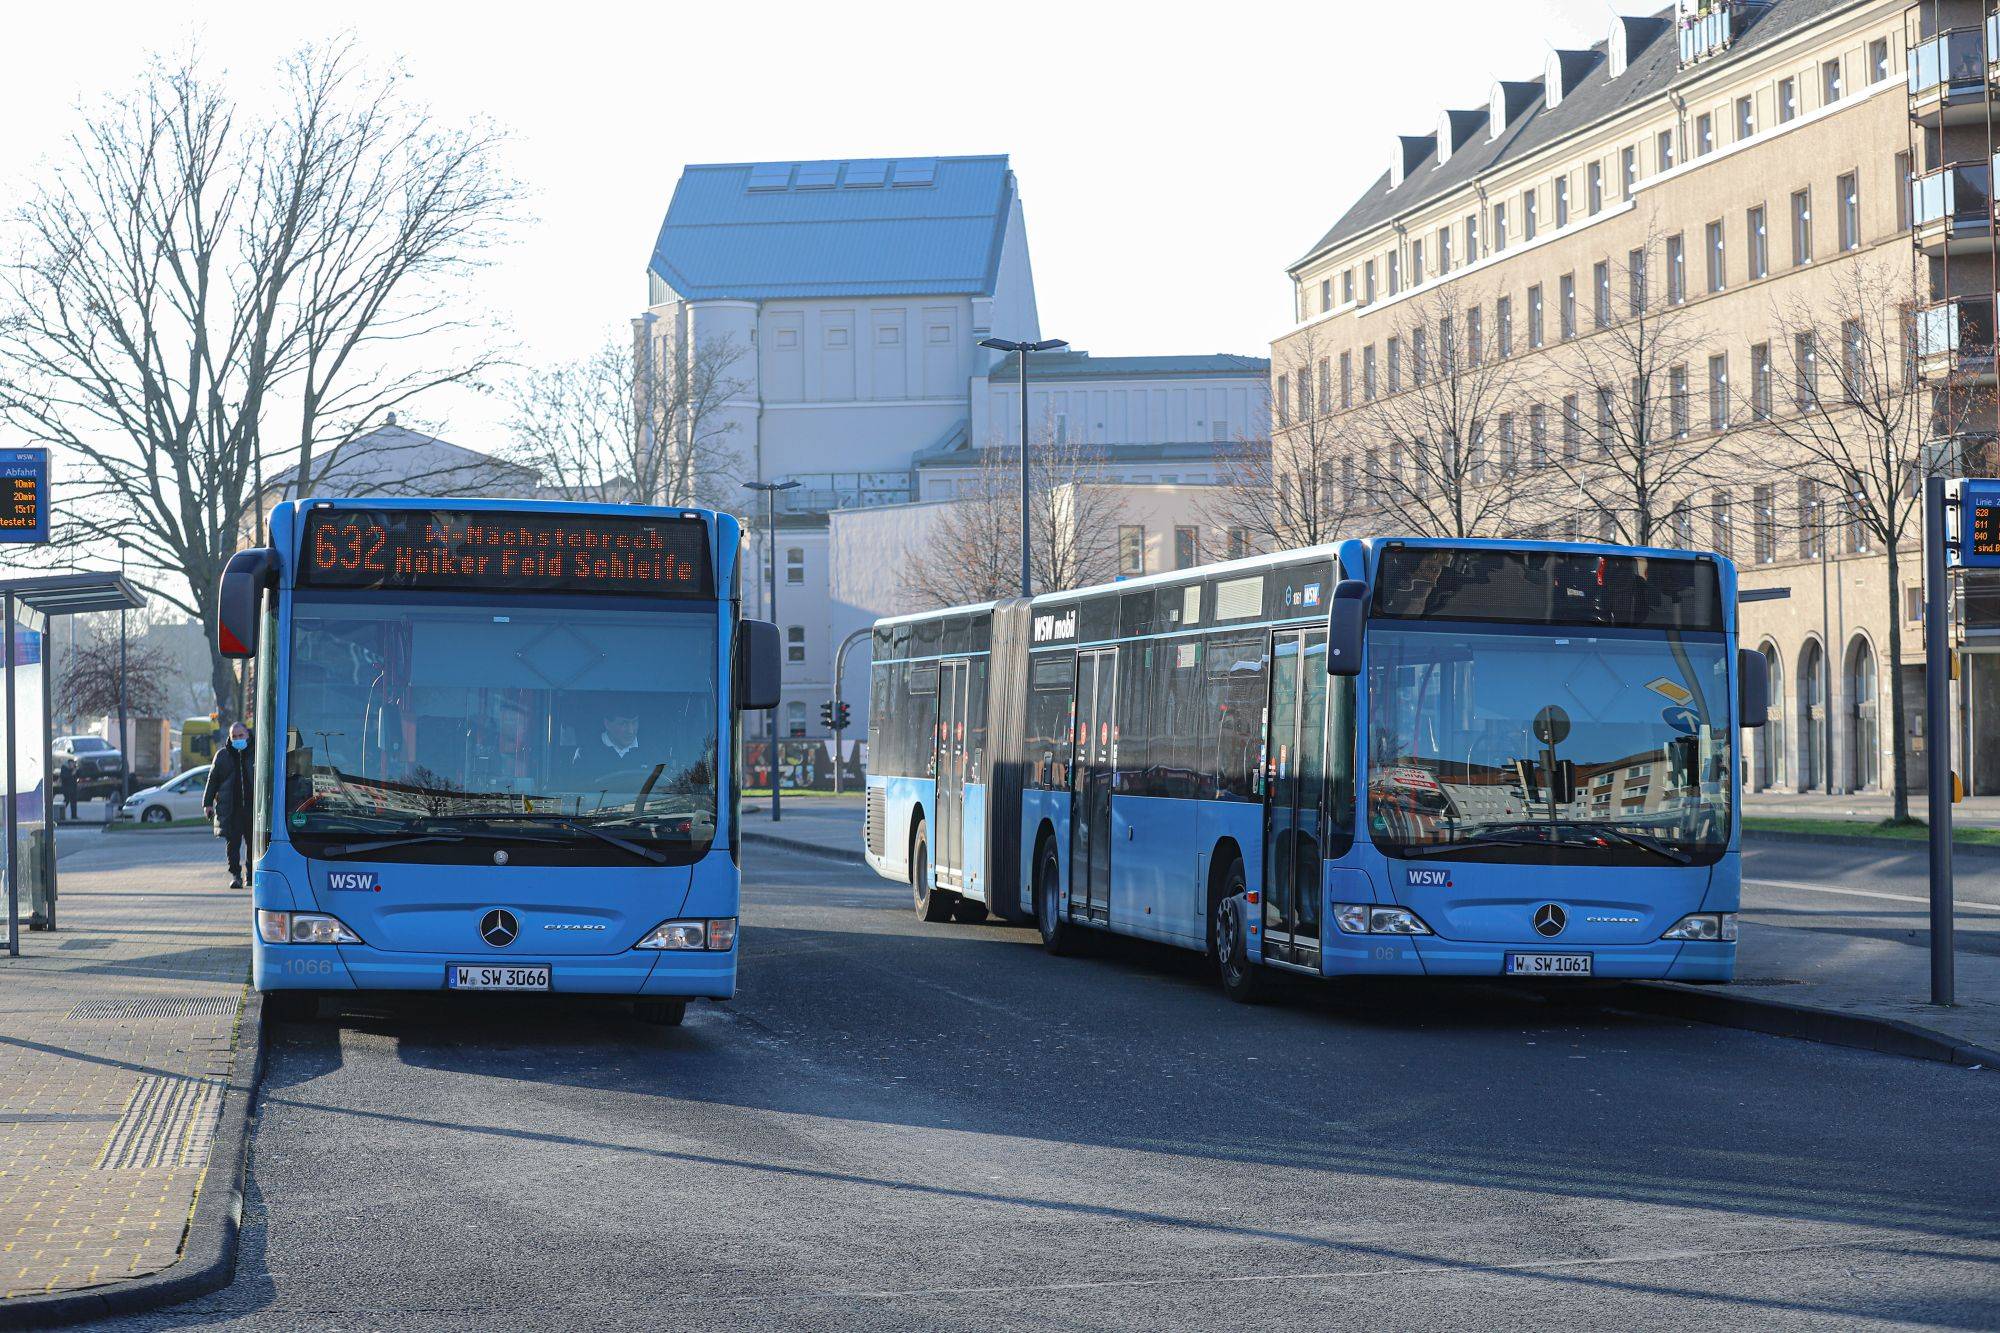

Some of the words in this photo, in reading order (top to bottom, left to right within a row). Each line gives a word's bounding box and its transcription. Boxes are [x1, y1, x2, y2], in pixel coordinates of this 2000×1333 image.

[5, 468, 37, 476] Abfahrt
[14, 480, 36, 488] 10min
[13, 492, 36, 501] 20min
[1975, 498, 1993, 506] Linie
[15, 504, 36, 514] 15:17
[1975, 508, 1989, 517] 628
[1974, 520, 1988, 529] 611
[1974, 532, 1988, 541] 640
[315, 524, 386, 570] 632
[395, 547, 489, 575] Hölker
[501, 549, 562, 577] Feld
[575, 551, 692, 580] Schleife
[1034, 615, 1054, 642] WSW
[1054, 610, 1076, 639] mobil
[330, 874, 373, 889] WSW
[1409, 871, 1446, 884] WSW
[285, 958, 332, 975] 1066
[1515, 956, 1525, 970] W
[458, 969, 469, 985] W
